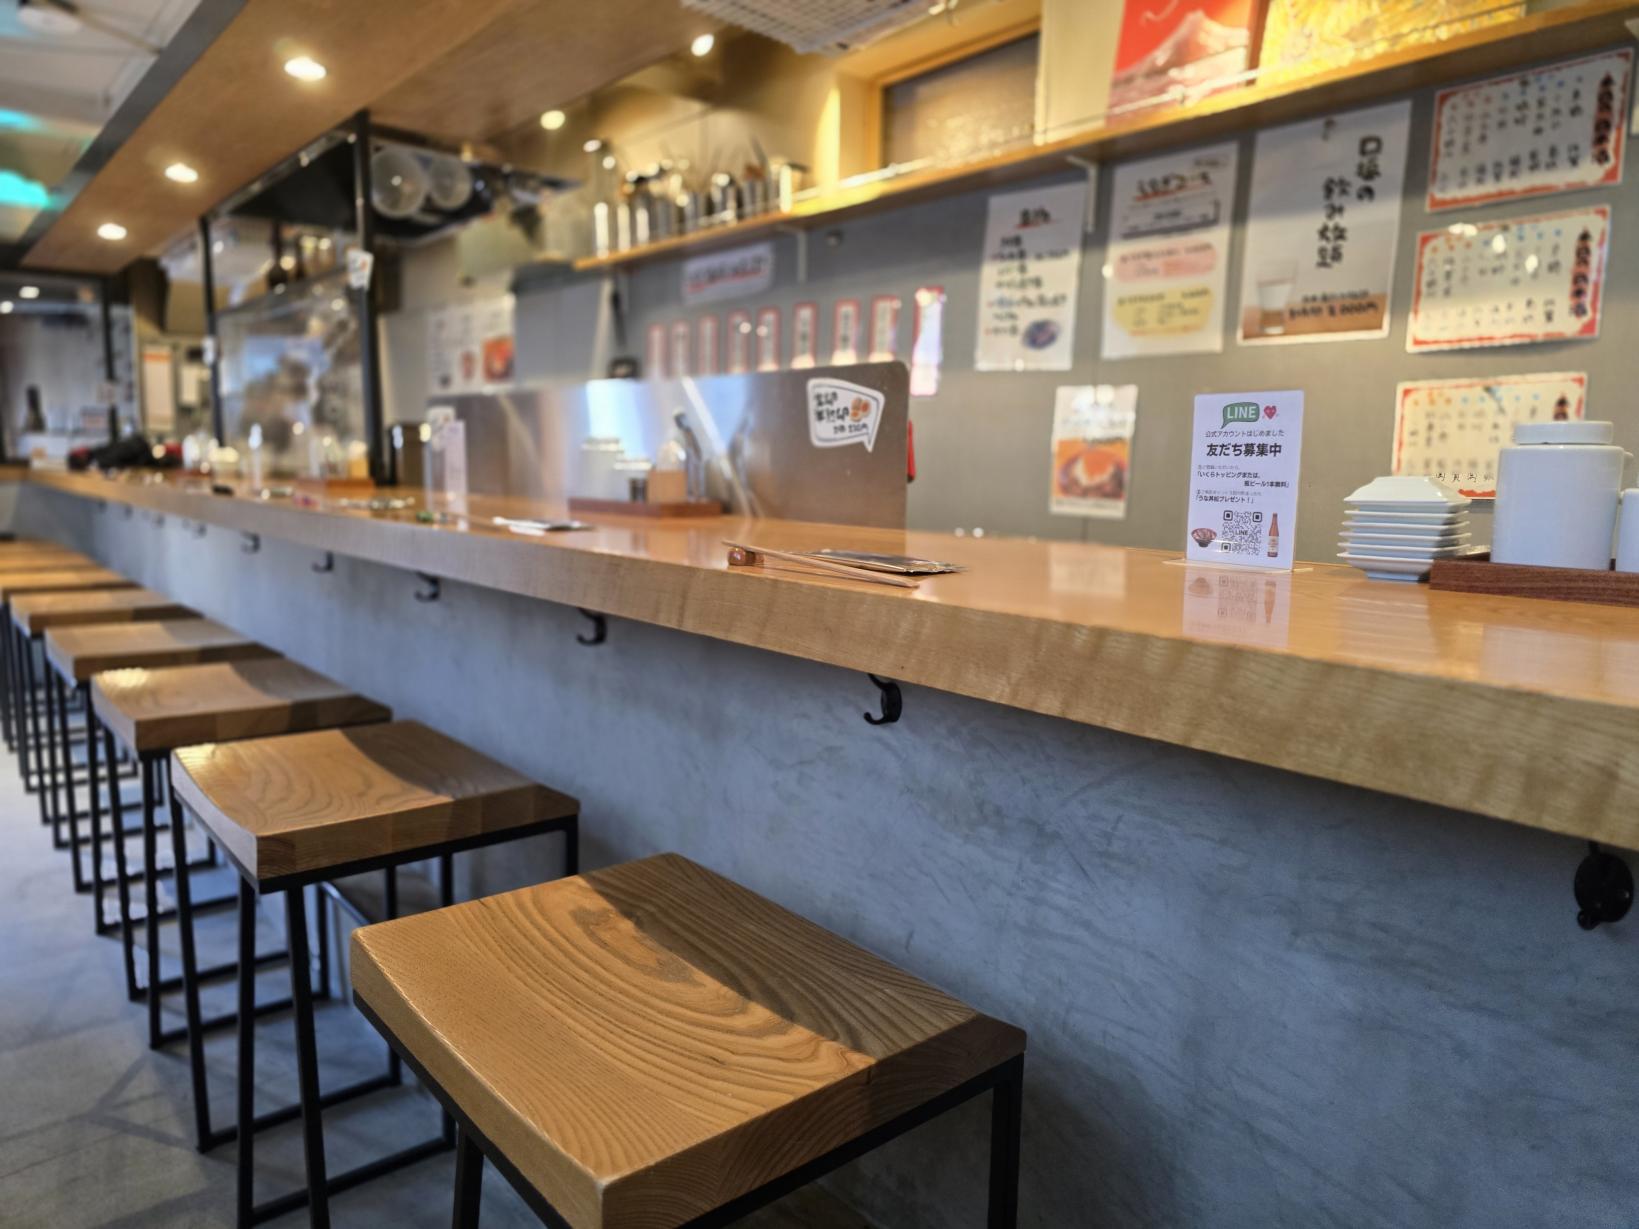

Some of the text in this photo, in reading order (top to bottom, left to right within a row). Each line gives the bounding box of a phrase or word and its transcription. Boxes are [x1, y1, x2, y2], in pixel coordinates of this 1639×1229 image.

[1226, 405, 1257, 419] LINE
[1205, 429, 1285, 438] 公式アカウントはじめました
[1206, 442, 1282, 457] 友だち募集中
